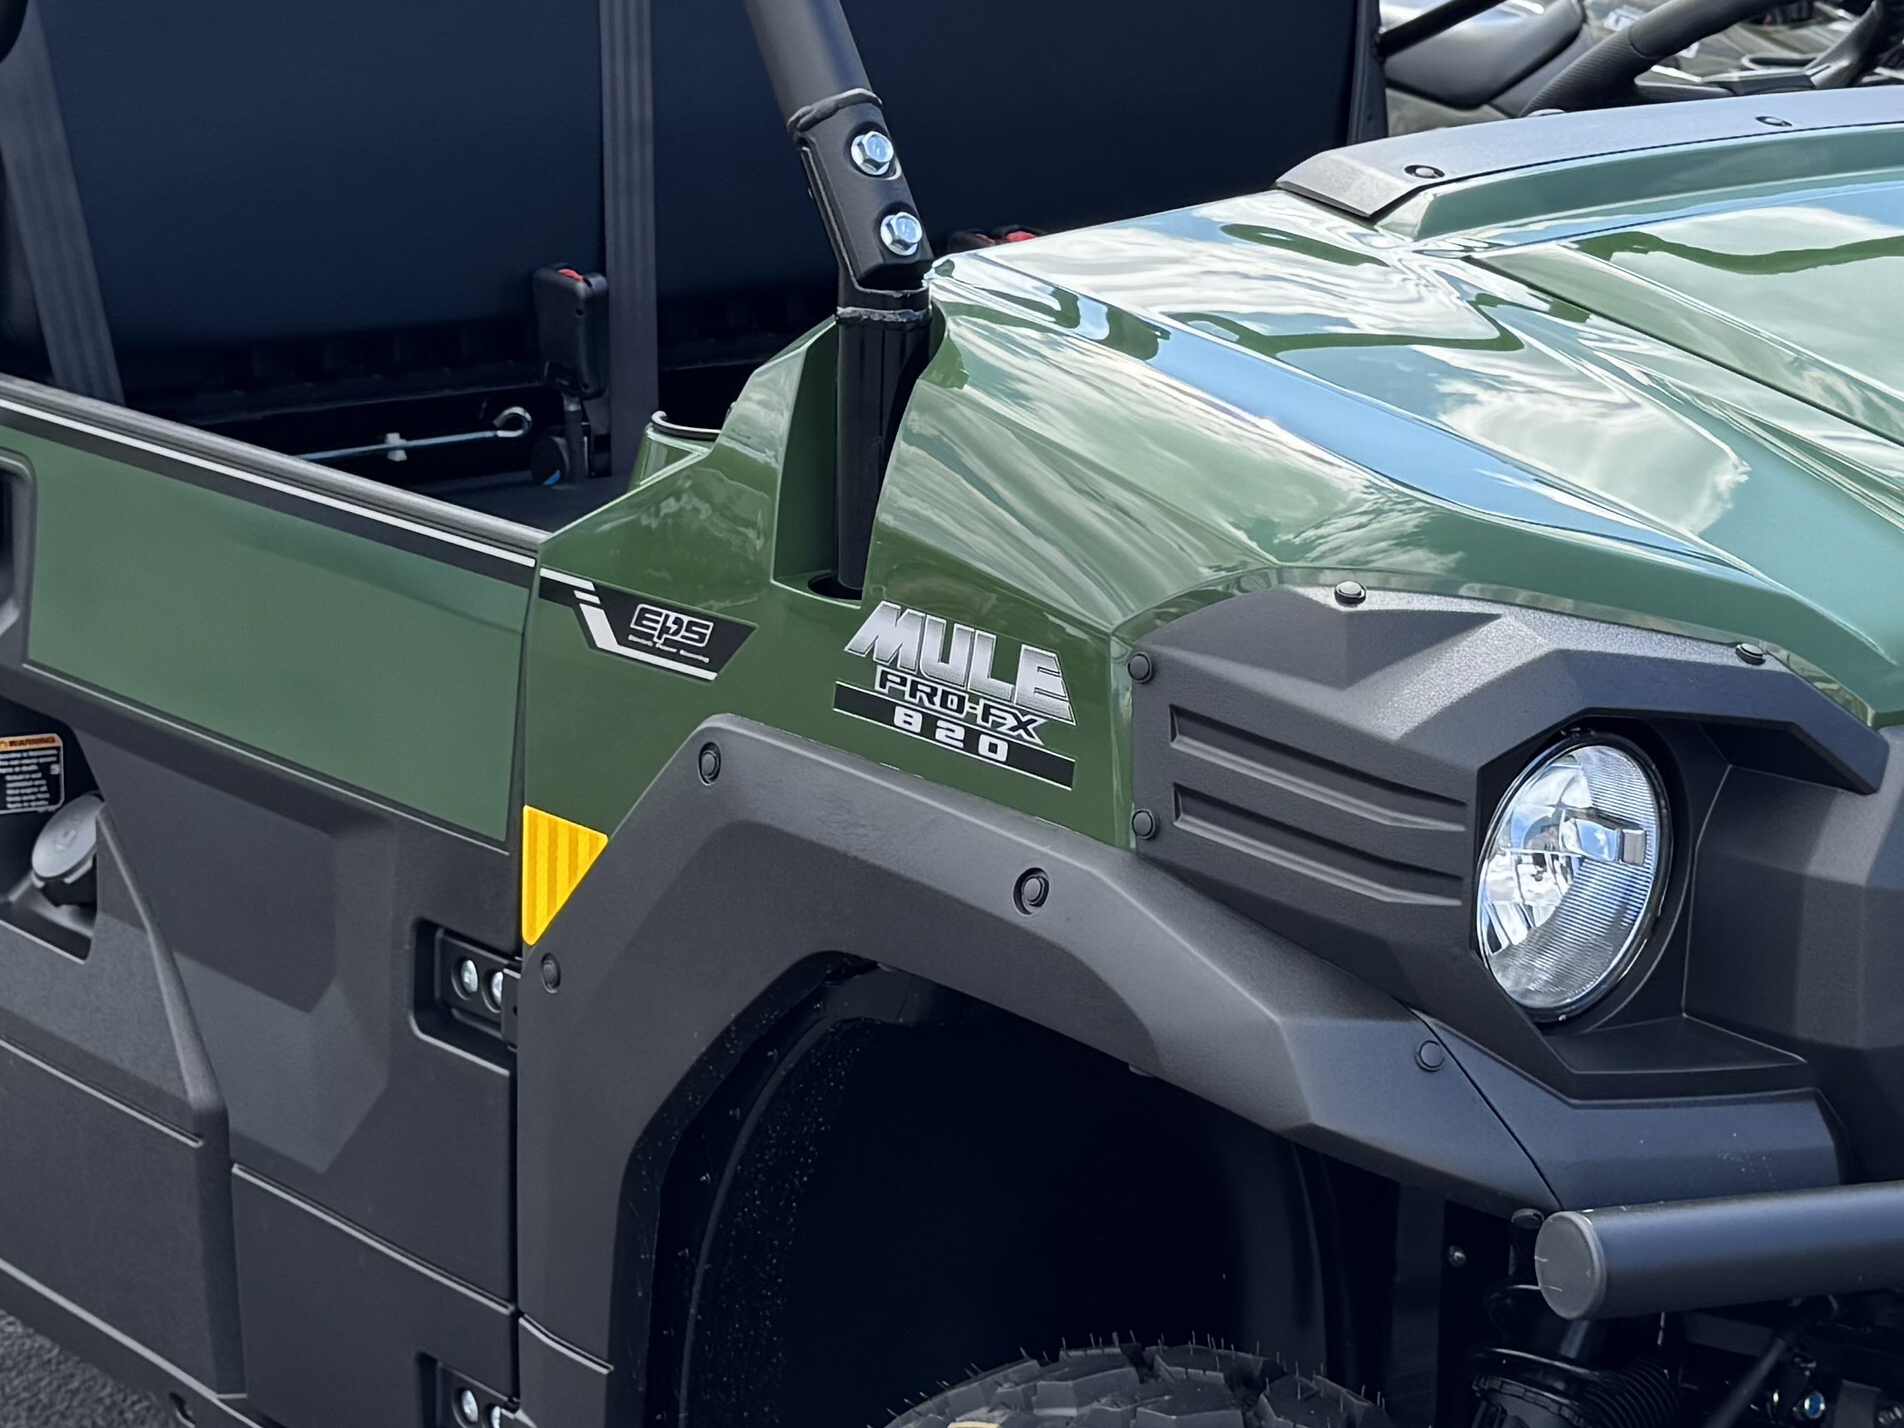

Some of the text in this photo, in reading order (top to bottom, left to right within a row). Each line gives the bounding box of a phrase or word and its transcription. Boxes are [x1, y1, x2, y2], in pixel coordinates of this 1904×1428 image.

[629, 603, 714, 648] EPS
[844, 600, 1077, 726] MULE
[875, 664, 1047, 746] PRO-FX
[893, 706, 1009, 762] 820
